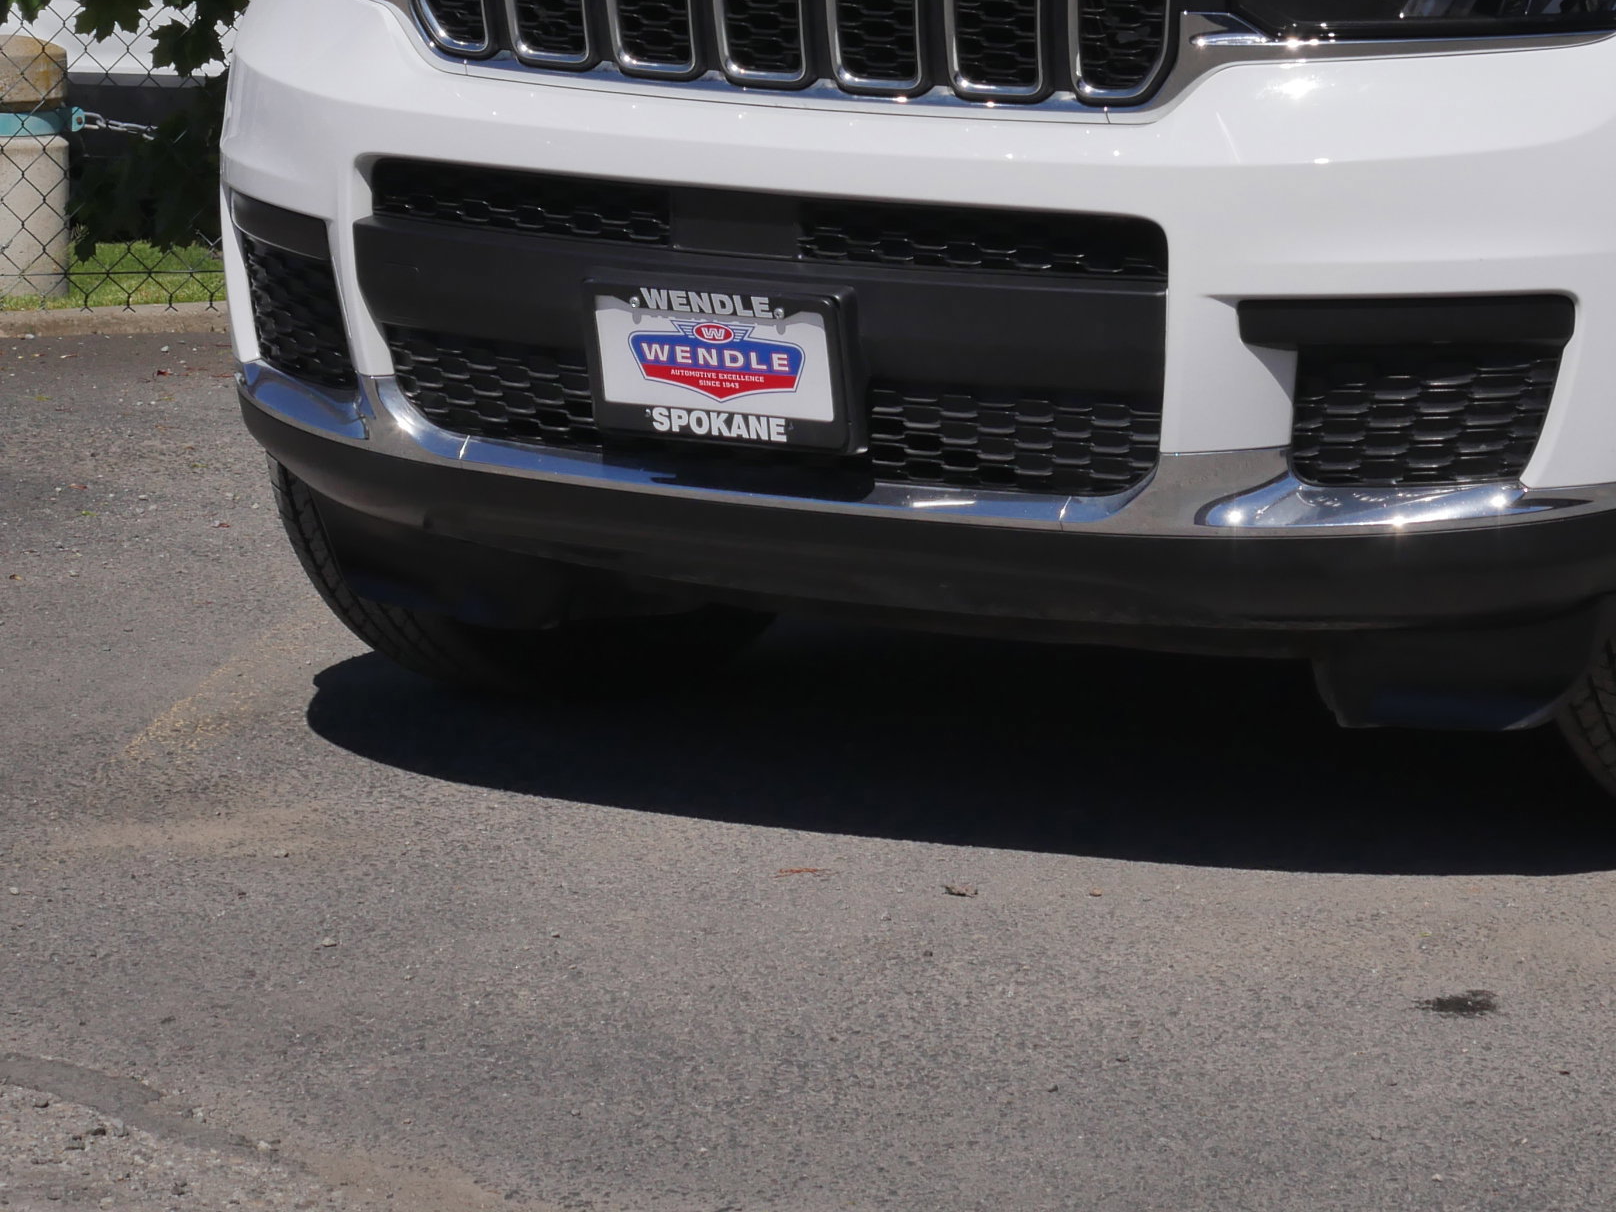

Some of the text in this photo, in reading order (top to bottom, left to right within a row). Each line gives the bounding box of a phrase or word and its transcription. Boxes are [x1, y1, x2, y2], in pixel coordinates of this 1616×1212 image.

[640, 287, 775, 320] WENDLE
[640, 341, 790, 372] WENDLE
[670, 368, 765, 383] AUTOMOTIVE EXCELLENCE
[698, 379, 720, 388] SINCE
[651, 406, 788, 443] SPOKANE
